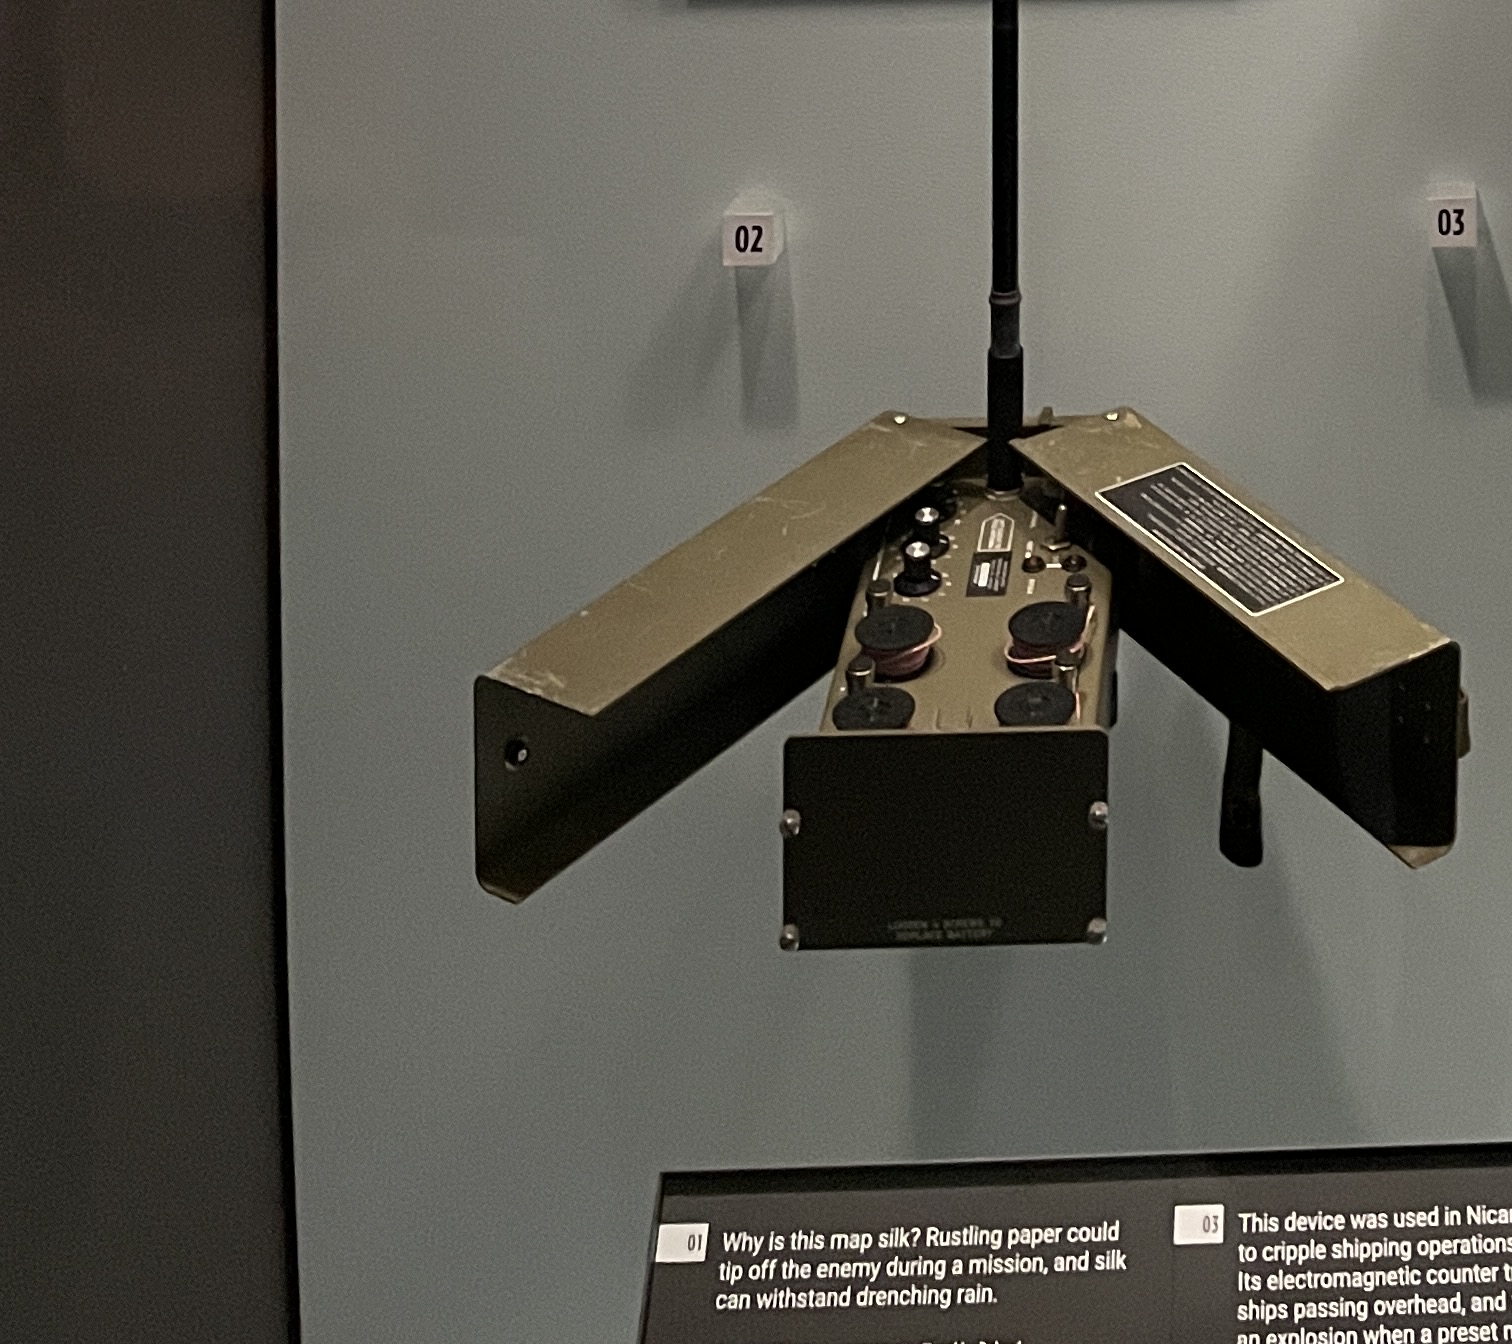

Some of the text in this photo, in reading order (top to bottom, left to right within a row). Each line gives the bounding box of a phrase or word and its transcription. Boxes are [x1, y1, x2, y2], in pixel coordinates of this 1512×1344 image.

[1438, 209, 1465, 236] 03
[735, 225, 763, 253] 02
[1202, 1215, 1220, 1234] 03
[1237, 1212, 1280, 1234] This
[1284, 1210, 1346, 1232] device
[1349, 1212, 1389, 1230] was
[1393, 1205, 1440, 1228] used
[1444, 1205, 1462, 1226] in
[688, 1234, 702, 1252] 01
[723, 1219, 1120, 1257] Why is this map silk? Rustling paper could
[1237, 1243, 1258, 1263] to
[1261, 1238, 1327, 1266] cripple
[1331, 1236, 1412, 1263] shipping
[719, 1248, 1127, 1286] tip off the enemy during a mission, and silk
[1238, 1270, 1262, 1292] Its
[1266, 1264, 1422, 1292] electromagnetic
[1425, 1263, 1500, 1285] counter
[715, 1282, 998, 1310] can withstand drenching rain.
[1236, 1298, 1289, 1325] ships
[1293, 1296, 1369, 1324] passing
[1373, 1291, 1466, 1317] overhead,
[1470, 1289, 1507, 1313] and
